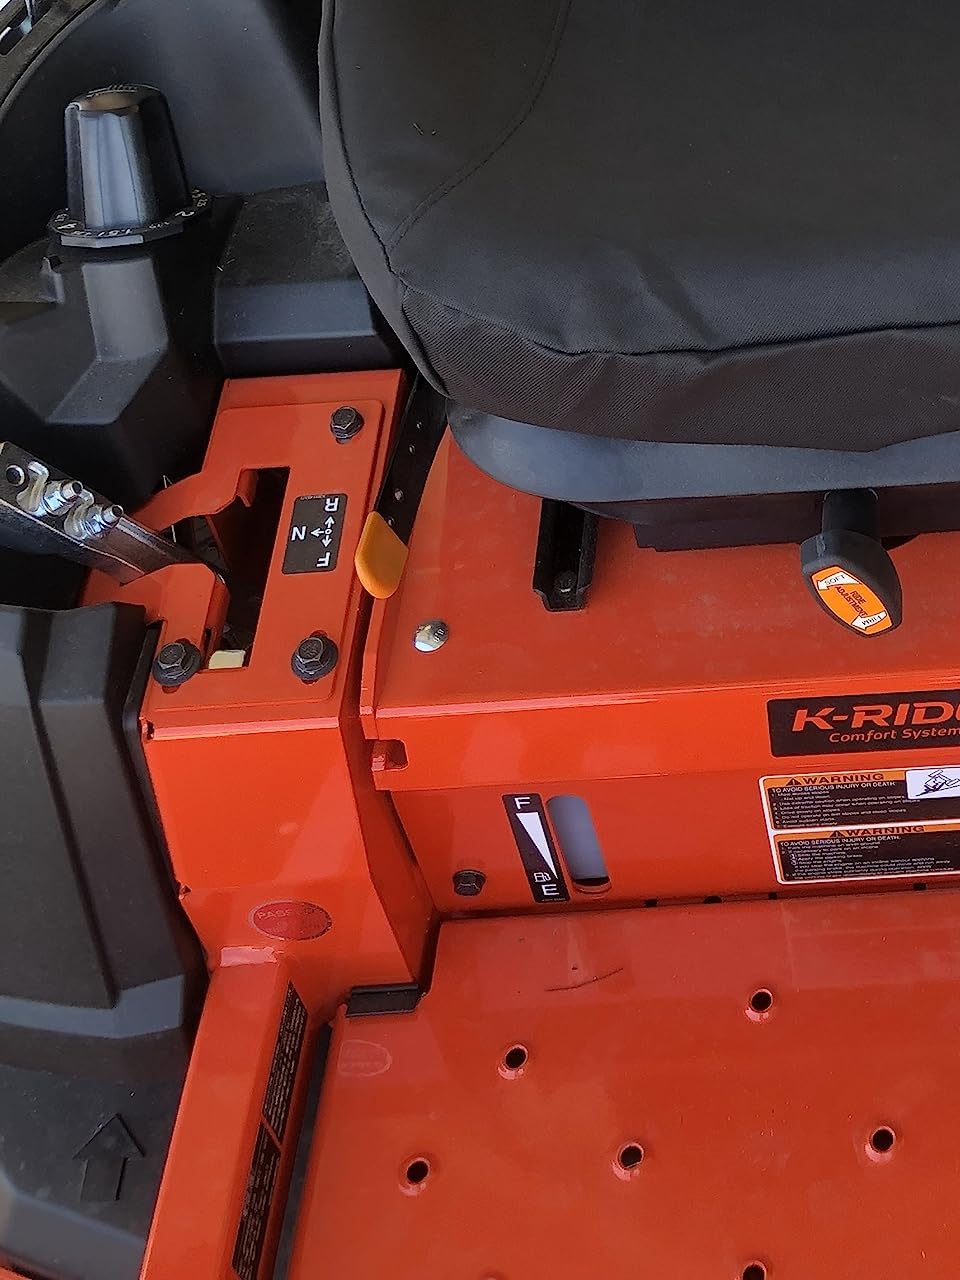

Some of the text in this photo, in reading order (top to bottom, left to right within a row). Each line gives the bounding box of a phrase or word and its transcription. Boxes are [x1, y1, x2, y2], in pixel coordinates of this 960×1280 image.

[325, 497, 339, 512] R
[291, 526, 307, 541] N
[316, 552, 331, 567] F
[835, 586, 868, 617] ADJUSTMENT
[850, 590, 867, 605] RIDE
[829, 728, 897, 743] Comfort
[802, 773, 885, 785] WARNING
[514, 796, 530, 810] F
[845, 825, 925, 837] WARNING
[541, 883, 560, 896] E
